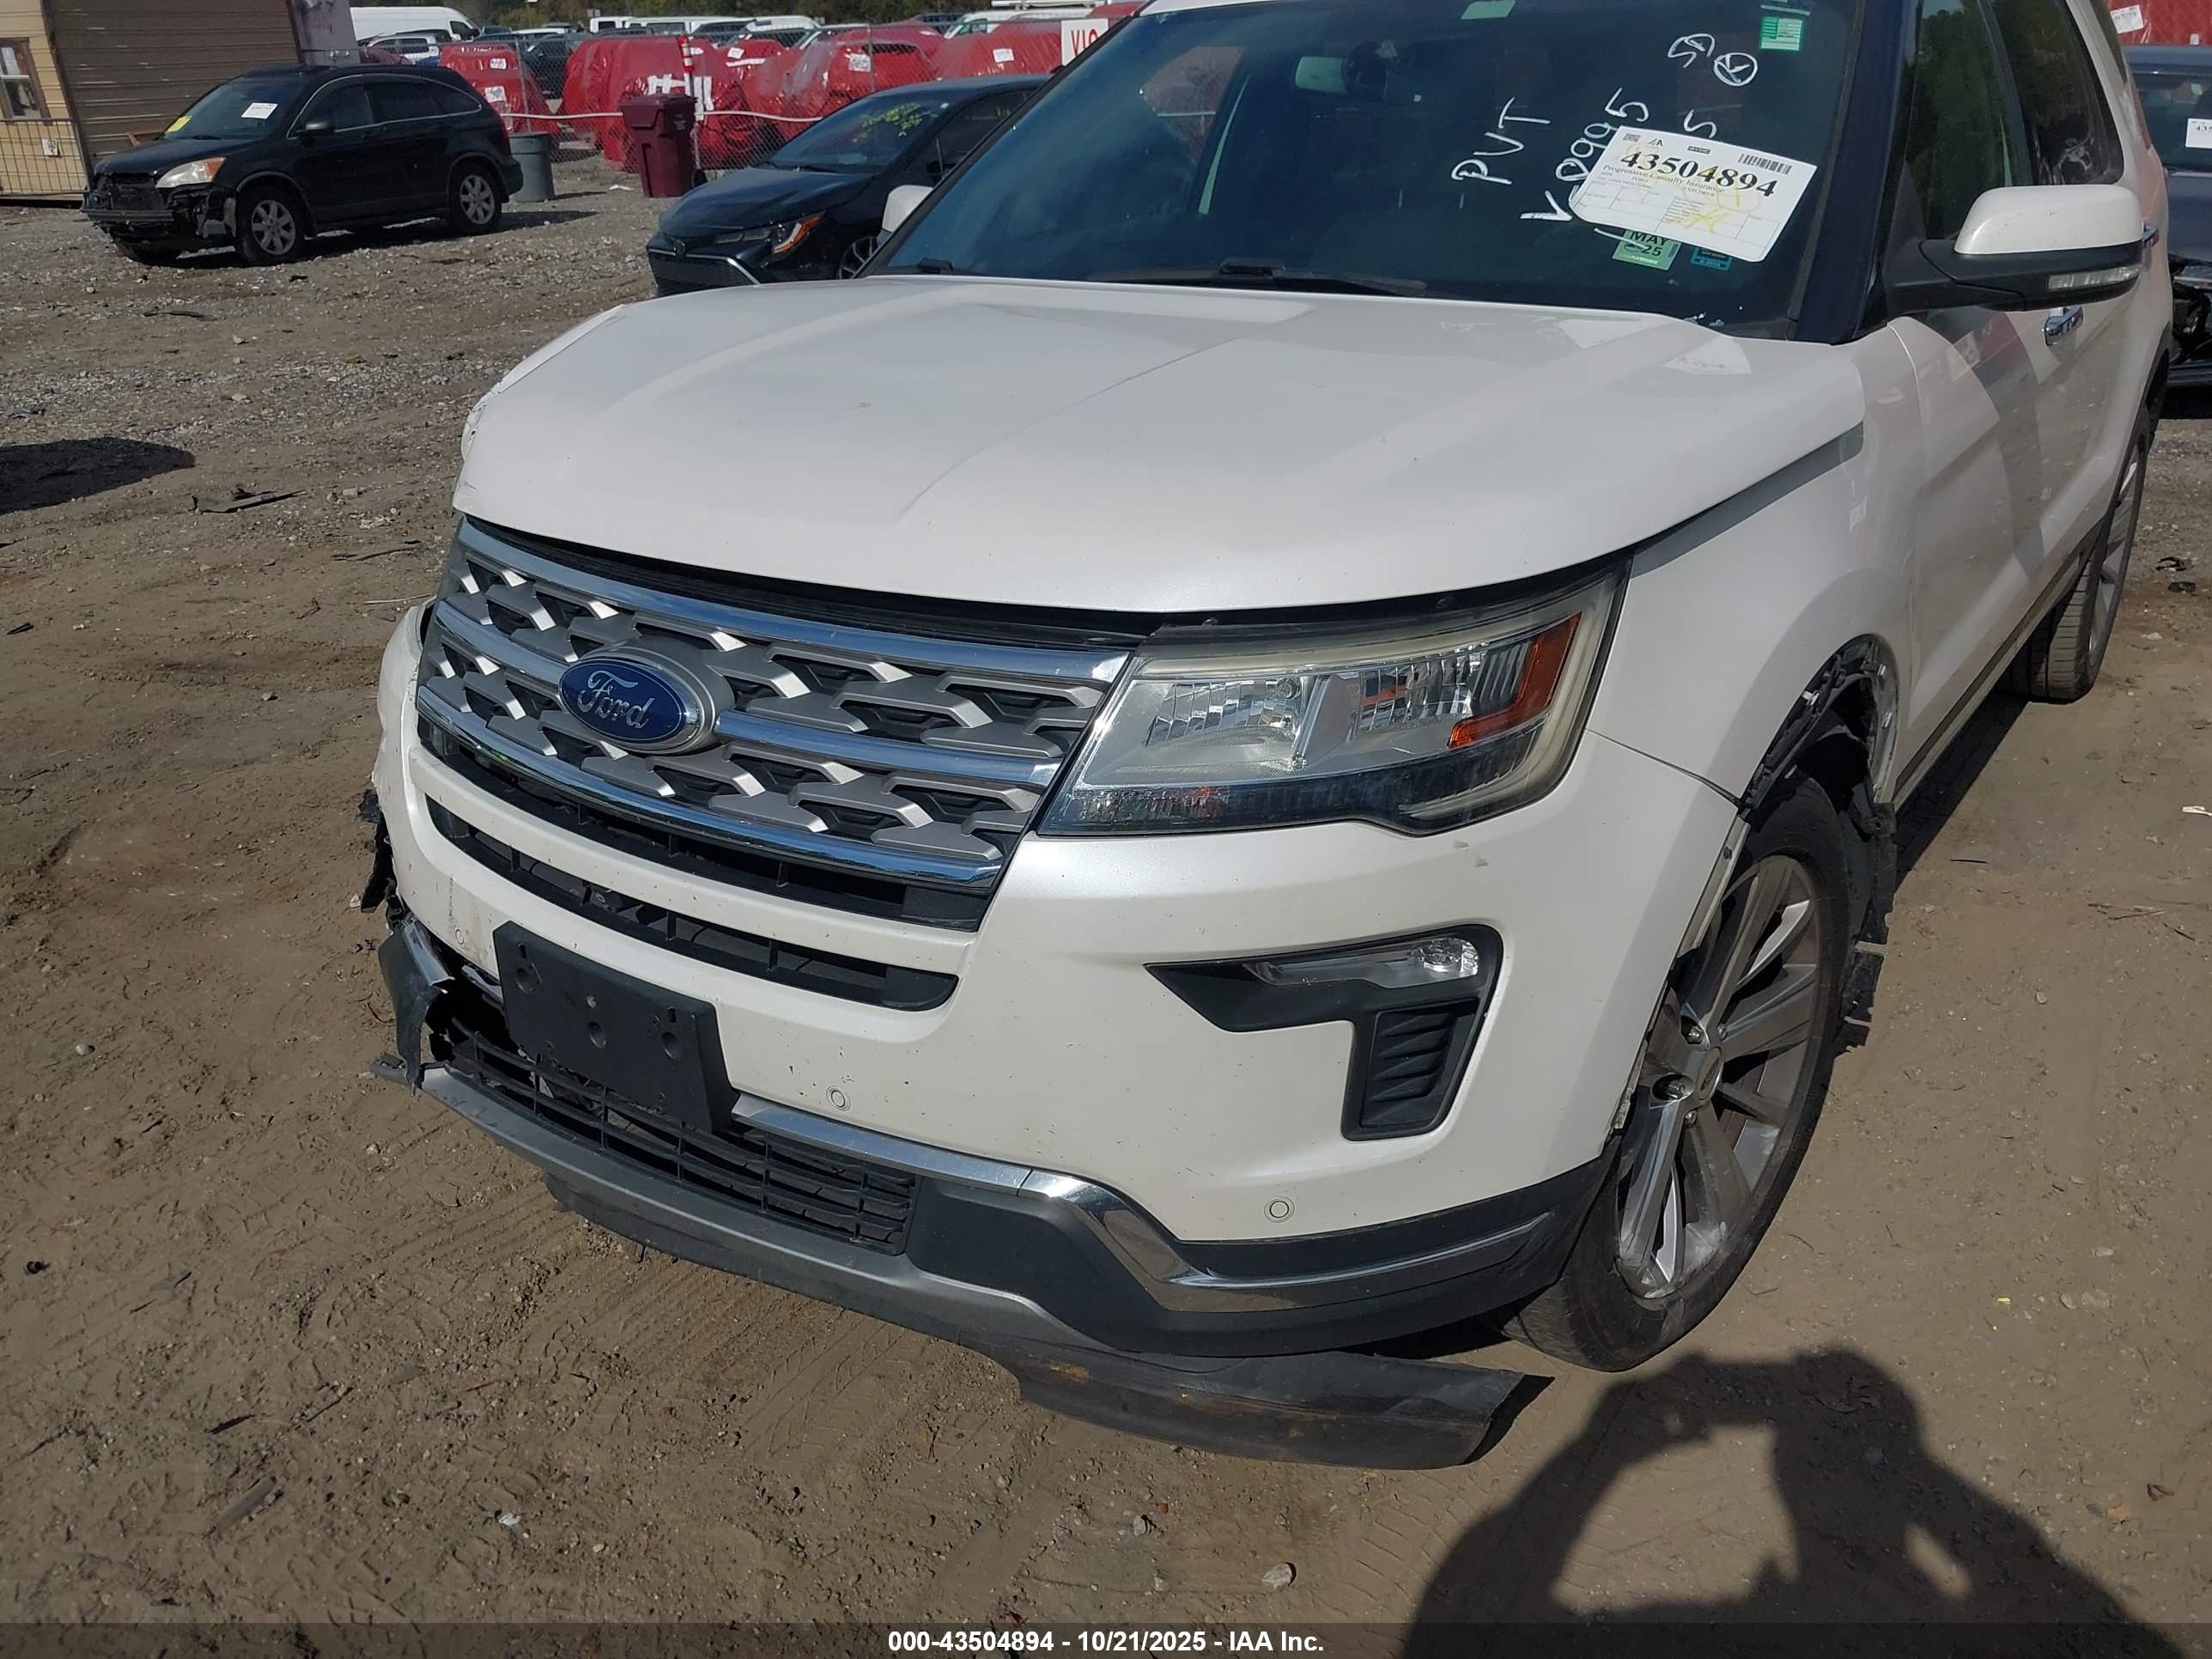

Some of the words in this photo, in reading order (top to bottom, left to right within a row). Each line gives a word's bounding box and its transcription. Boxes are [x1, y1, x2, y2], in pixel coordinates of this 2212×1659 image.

[1451, 97, 1551, 185] PVT
[1620, 150, 1778, 198] 43504894
[1650, 173, 1684, 186] Casualty
[1686, 178, 1725, 193] Insurance
[1631, 230, 1669, 246] MAY
[1640, 246, 1663, 257] 25
[577, 670, 655, 729] Ford
